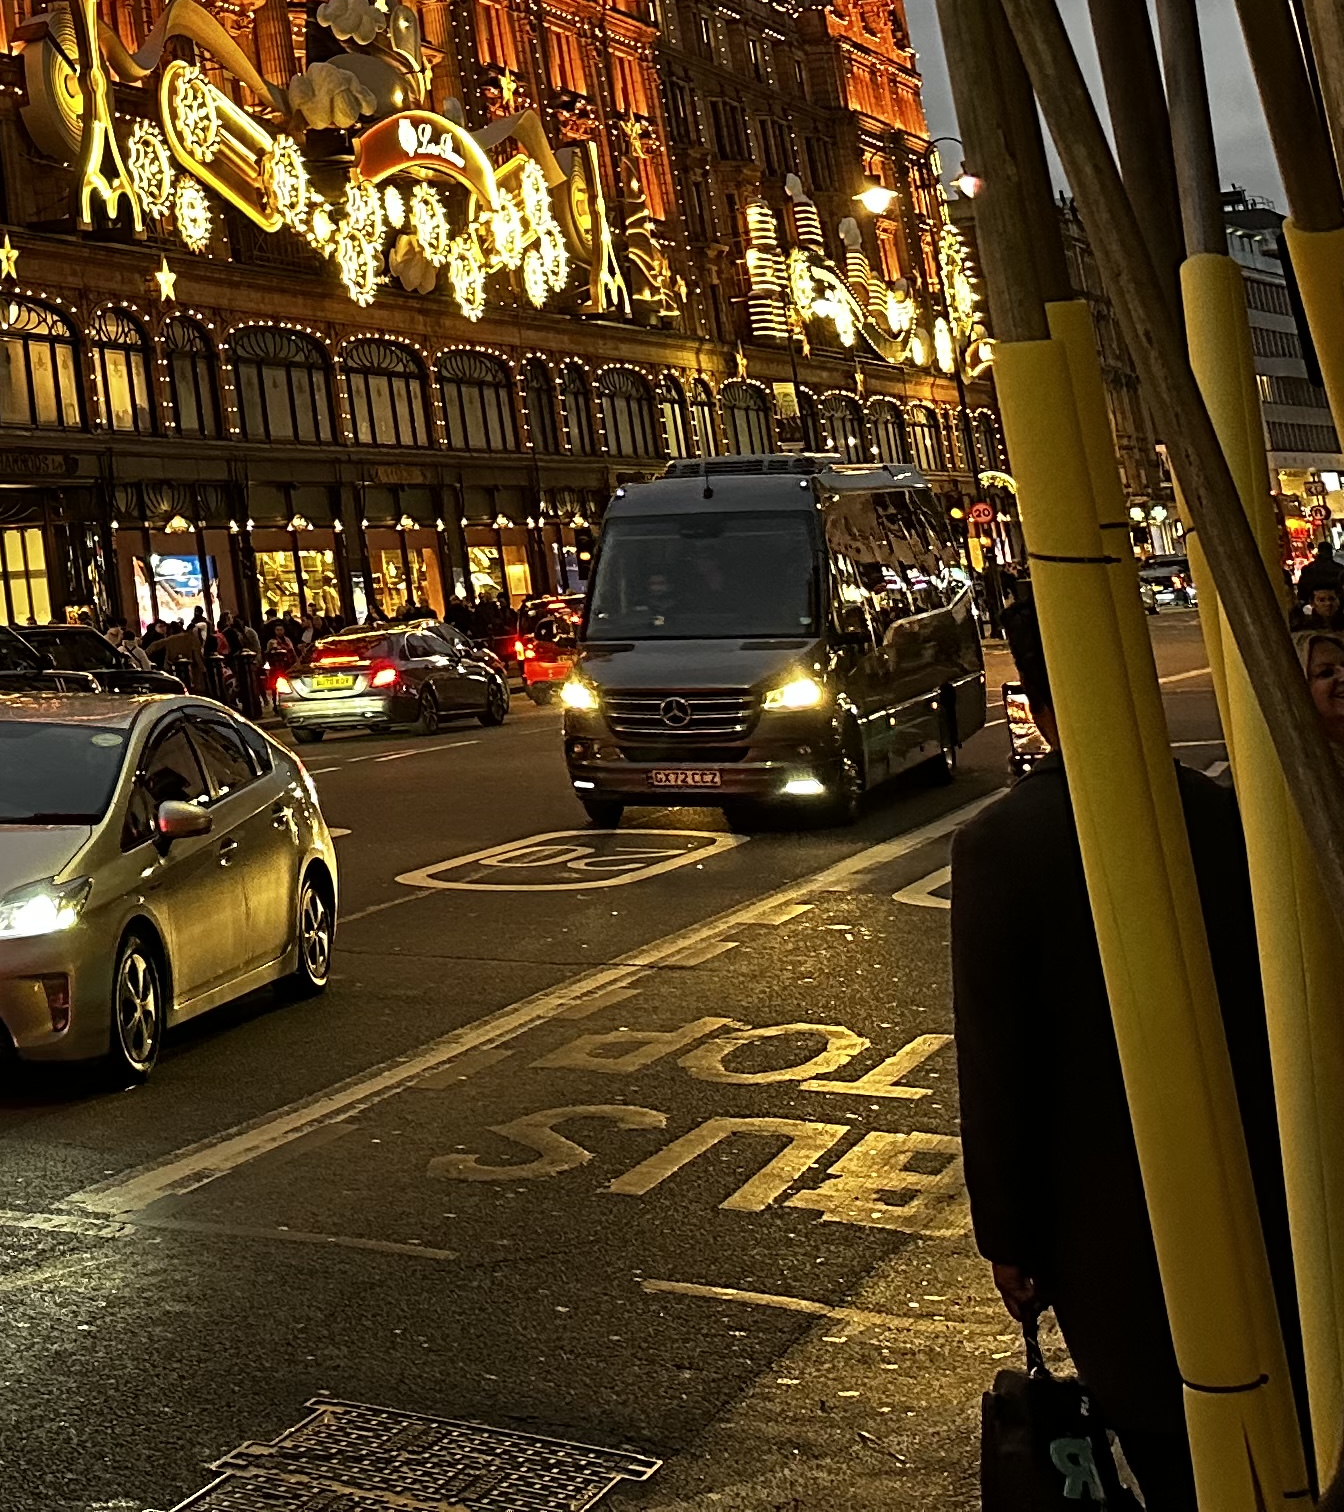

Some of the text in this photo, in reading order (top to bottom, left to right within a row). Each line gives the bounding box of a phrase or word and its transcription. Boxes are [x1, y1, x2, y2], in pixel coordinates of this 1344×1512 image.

[974, 507, 990, 518] 20
[654, 771, 689, 784] GX72
[478, 844, 684, 872] 20
[529, 1016, 955, 1099] TOP
[426, 1104, 974, 1237] BUS
